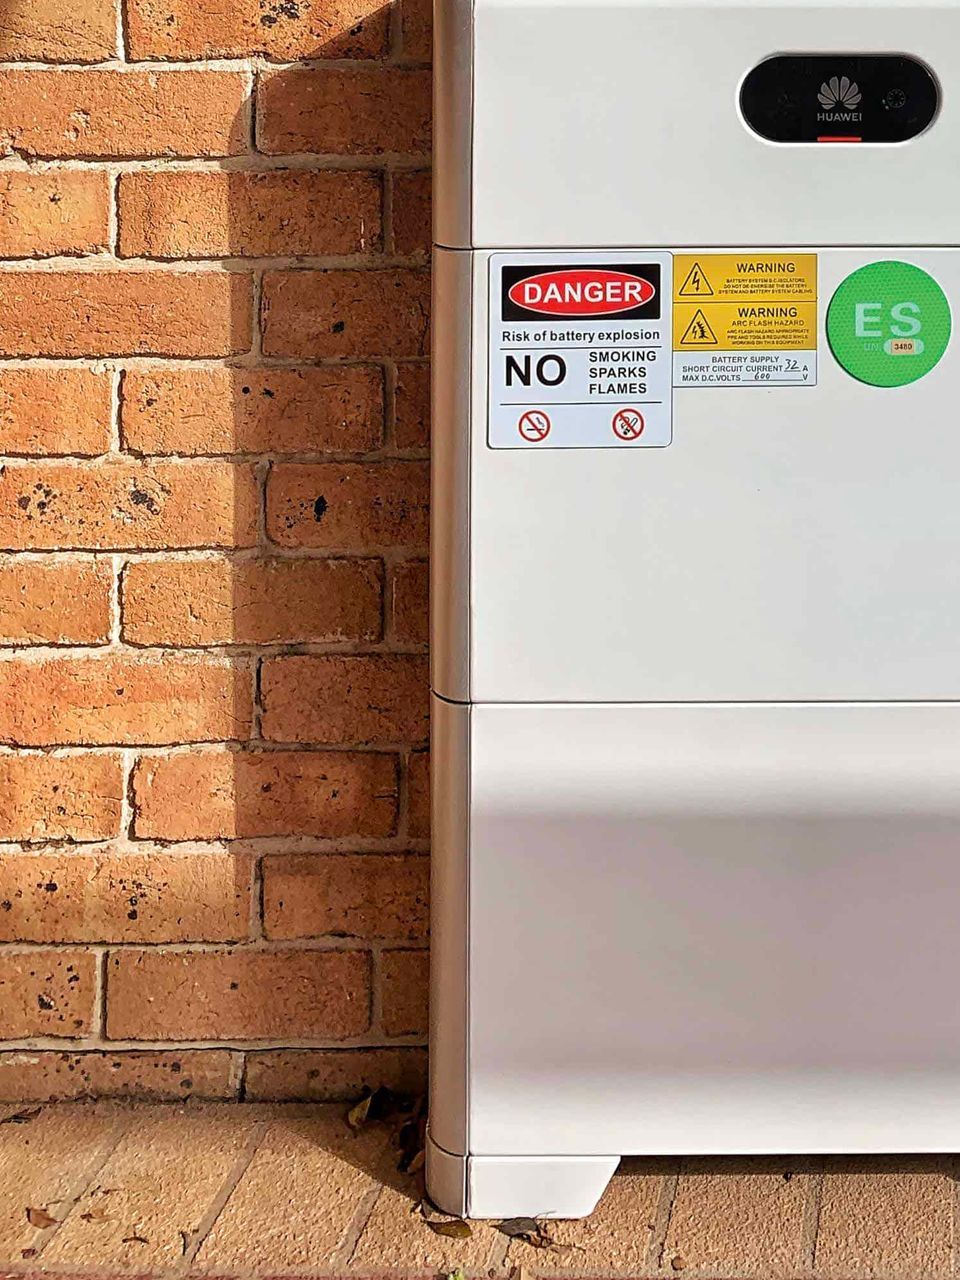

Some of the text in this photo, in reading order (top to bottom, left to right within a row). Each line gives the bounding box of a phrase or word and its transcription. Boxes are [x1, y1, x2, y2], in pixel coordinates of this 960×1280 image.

[817, 113, 863, 122] HUAWEI
[736, 262, 796, 273] WARNING
[524, 281, 643, 304] DANGER
[738, 307, 798, 318] WARNING
[855, 301, 922, 337] ES
[502, 329, 660, 344] Risk of battery explosion
[894, 343, 913, 351] 3480
[589, 350, 657, 363] SMOKING
[682, 365, 710, 373] SHORT
[785, 358, 800, 370] 32
[505, 354, 567, 387] NO
[589, 366, 647, 379] SPARKS
[682, 374, 699, 382] MAX
[754, 372, 771, 381] 600
[802, 373, 809, 381] V
[589, 382, 647, 395] FLAMES
